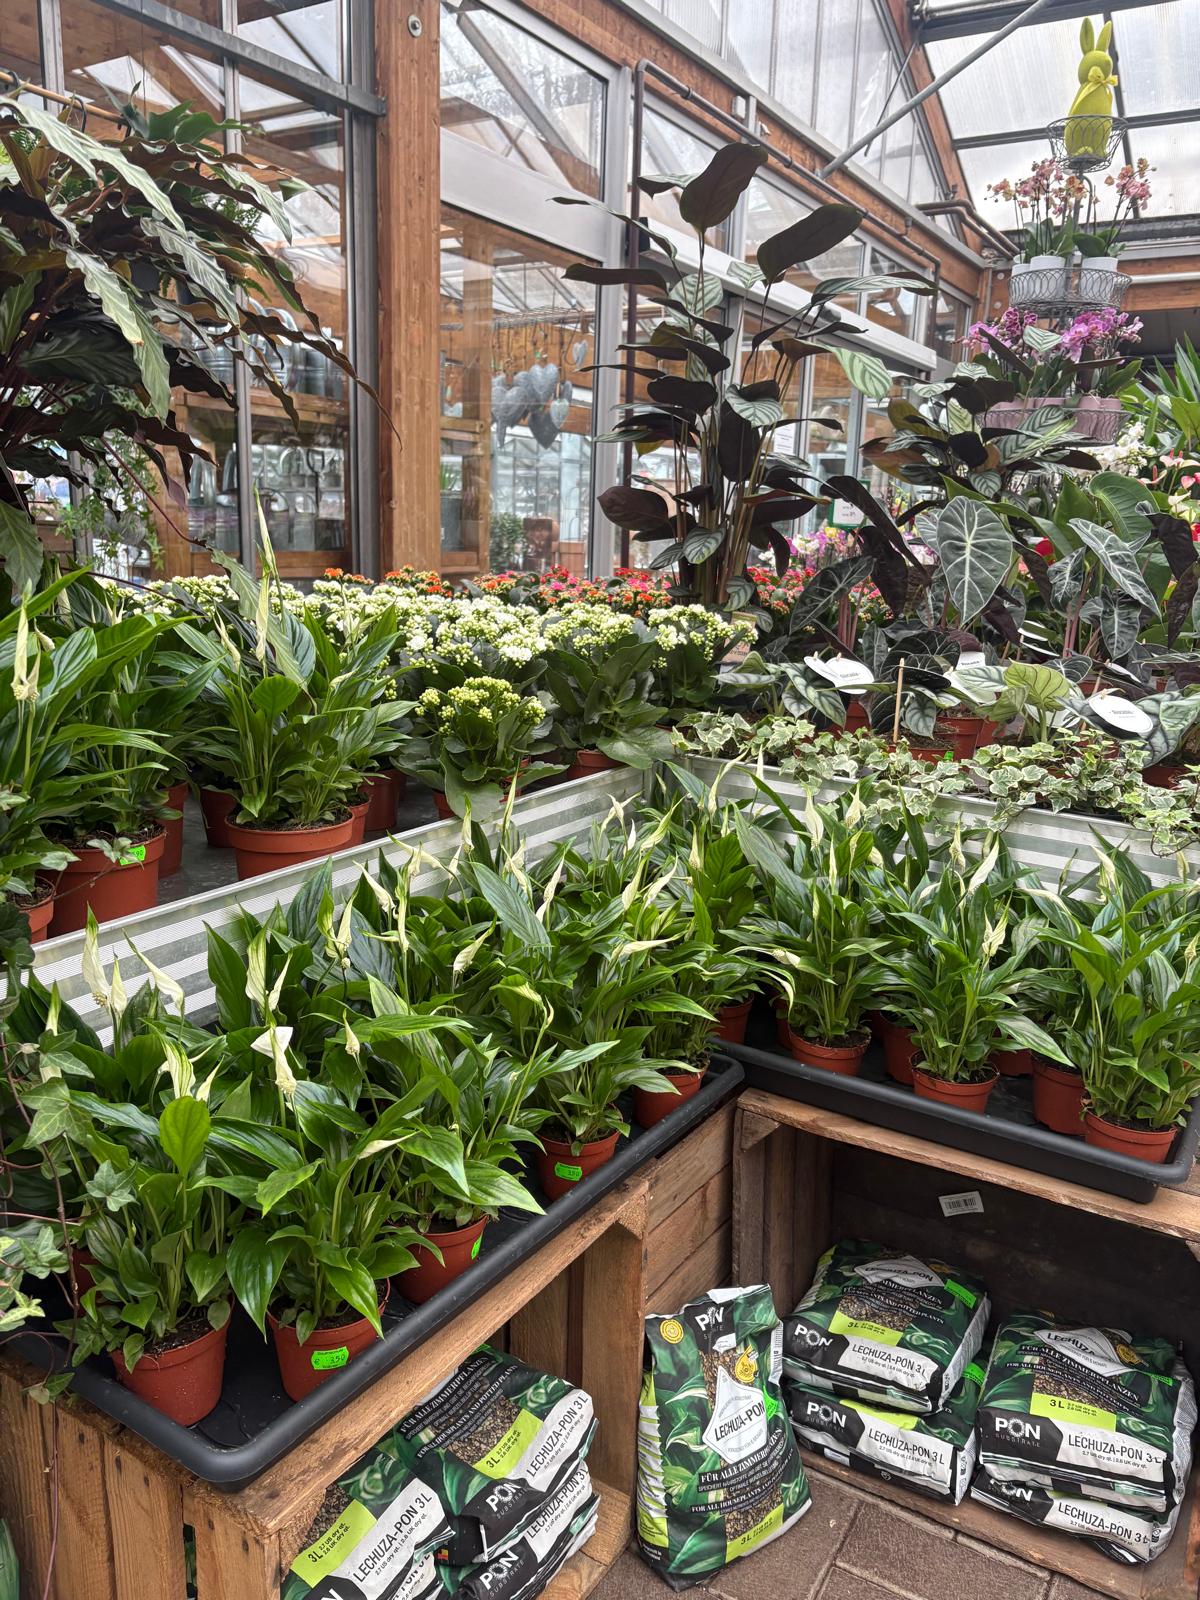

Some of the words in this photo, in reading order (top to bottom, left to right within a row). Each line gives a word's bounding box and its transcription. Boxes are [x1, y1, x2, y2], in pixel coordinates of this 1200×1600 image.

[794, 1324, 834, 1347] PON
[852, 1344, 915, 1371] LECHUZA-PON
[1041, 1348, 1061, 1358] ALLE
[1062, 1356, 1138, 1401] ZIMMERPFLANZEN
[479, 1381, 500, 1404] POTTED
[573, 1399, 583, 1410] 3
[577, 1396, 589, 1404] L
[400, 1416, 417, 1433] FÜR
[806, 1402, 847, 1428] PON
[995, 1417, 1041, 1440] PON
[526, 1408, 578, 1477] LECHUZA-PON
[868, 1428, 930, 1458] LECHUZA-PON
[932, 1451, 938, 1462] 3
[939, 1454, 945, 1464] L
[995, 1433, 1041, 1448] SUBSTRATE
[1068, 1434, 1143, 1460] LECHUZA-PON
[1146, 1452, 1153, 1463] 3
[701, 1472, 719, 1483] FÜR
[720, 1464, 739, 1480] ALLE
[485, 1482, 522, 1512] PON
[526, 1477, 579, 1539] LECHUZA-PON
[332, 1529, 340, 1538] dry
[1058, 1502, 1132, 1540] LECHUZA-PON
[1134, 1532, 1142, 1543] 3
[337, 1532, 345, 1541] dry
[353, 1505, 419, 1583] LECHUZA-PON
[415, 1497, 426, 1509] 3
[421, 1492, 433, 1503] L
[380, 1561, 388, 1569] US
[386, 1553, 395, 1563] dry
[407, 1526, 416, 1535] UK
[414, 1518, 422, 1528] dry
[479, 1549, 519, 1590] PON
[490, 1560, 525, 1597] SUBSTRATE
